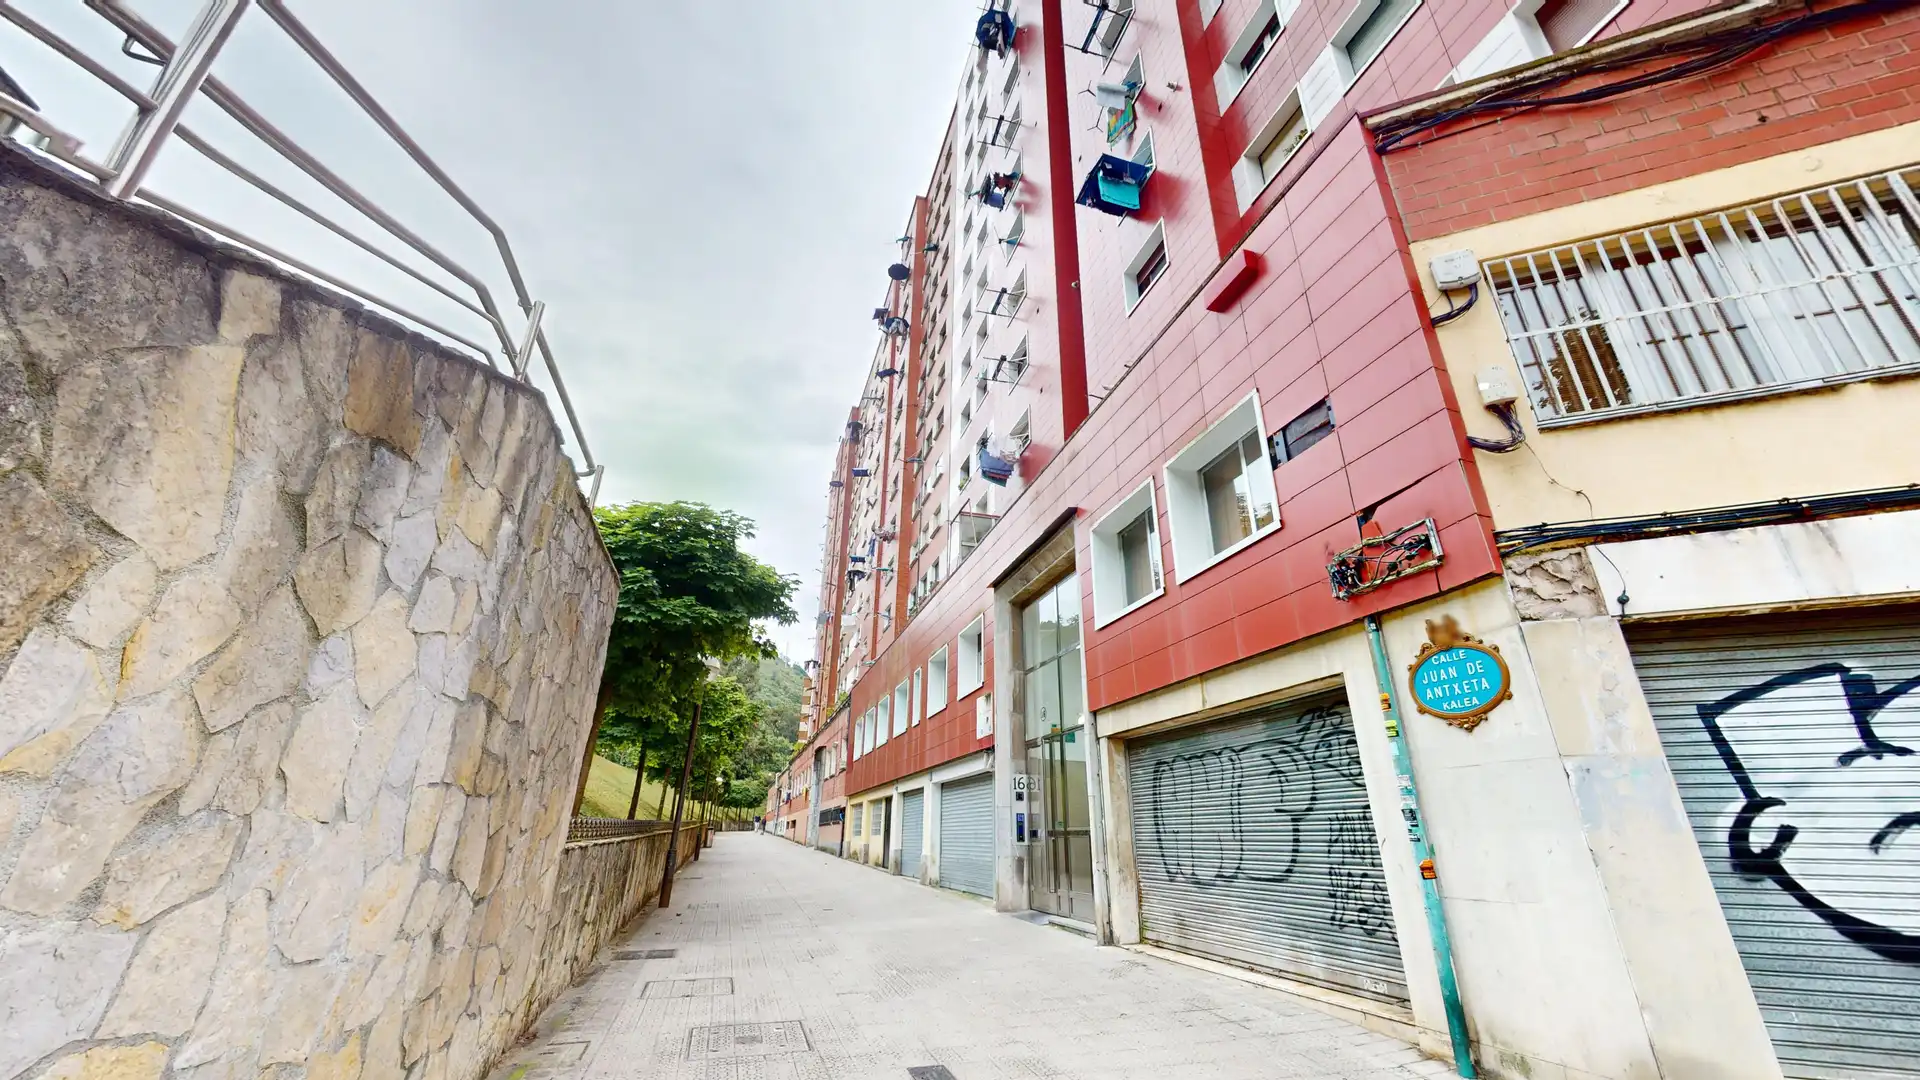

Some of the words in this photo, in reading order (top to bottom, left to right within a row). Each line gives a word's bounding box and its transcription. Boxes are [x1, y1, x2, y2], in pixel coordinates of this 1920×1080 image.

[1432, 650, 1467, 665] CALLE
[1422, 666, 1457, 684] JUAN
[1466, 660, 1484, 675] DE
[1426, 677, 1490, 701] ANTXETA
[1443, 697, 1479, 711] KALEA
[1013, 777, 1025, 790] 16
